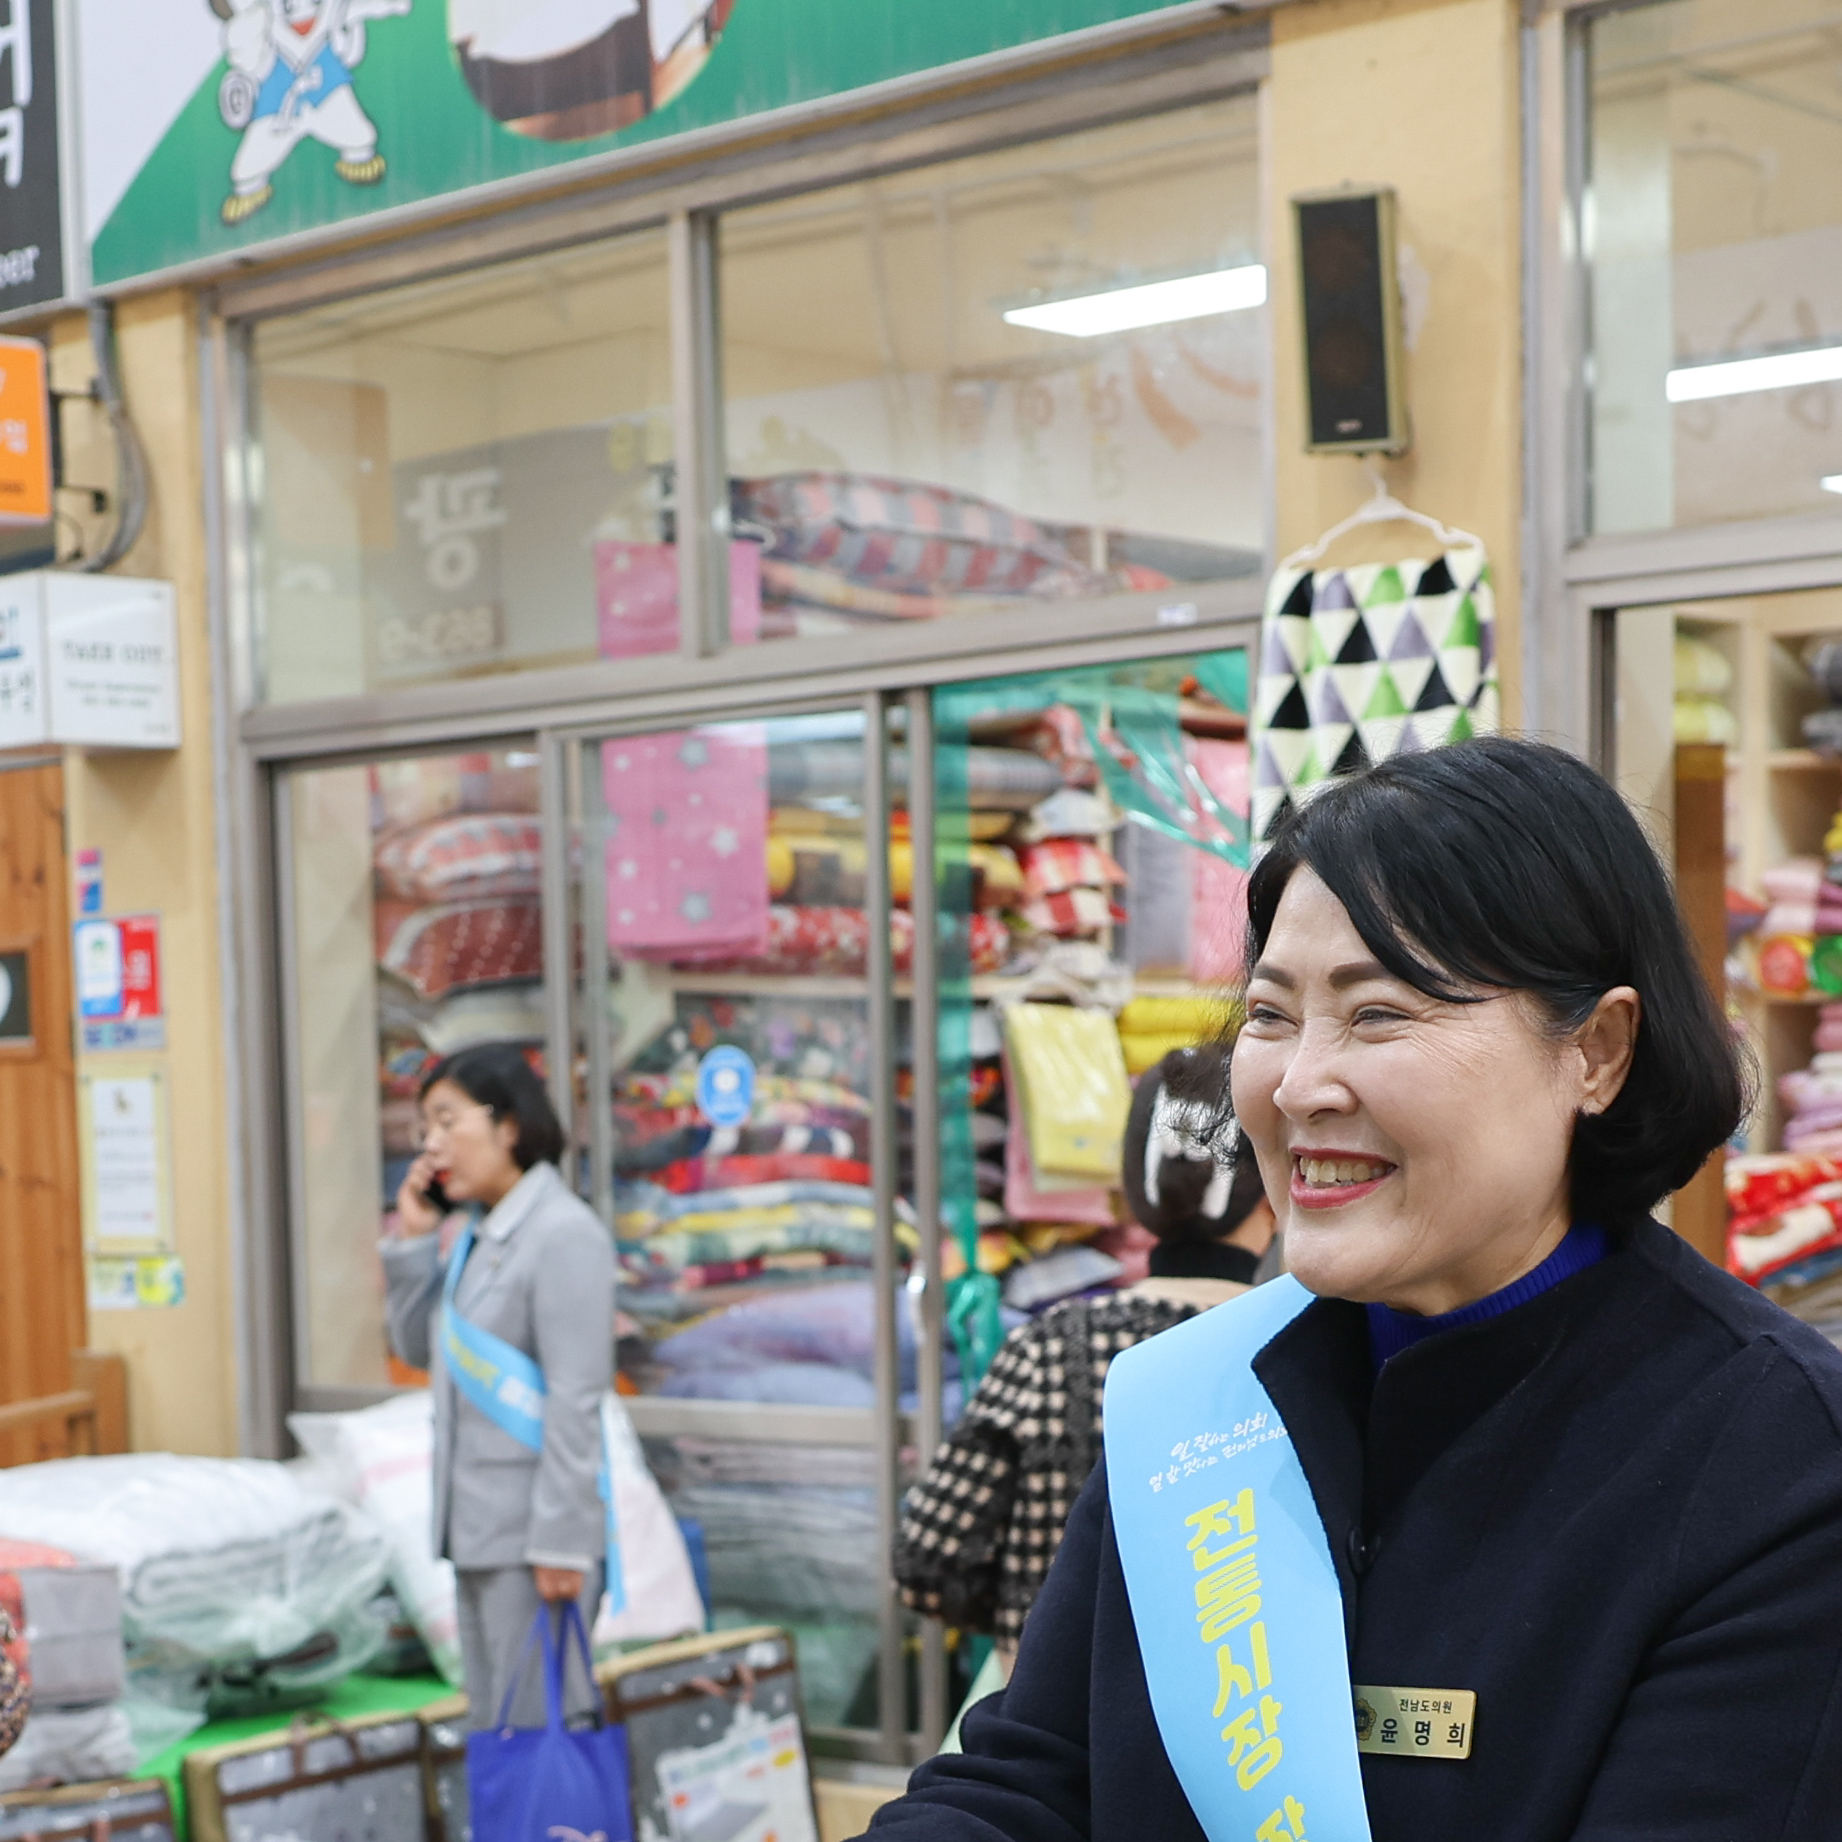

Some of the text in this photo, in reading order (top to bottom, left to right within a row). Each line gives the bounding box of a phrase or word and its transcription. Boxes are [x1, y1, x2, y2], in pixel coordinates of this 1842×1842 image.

[1171, 1439, 1195, 1462] 일
[1232, 1411, 1268, 1438] 의회
[1184, 1487, 1283, 1792] 전통시장
[1399, 1698, 1453, 1715] 전남도의원
